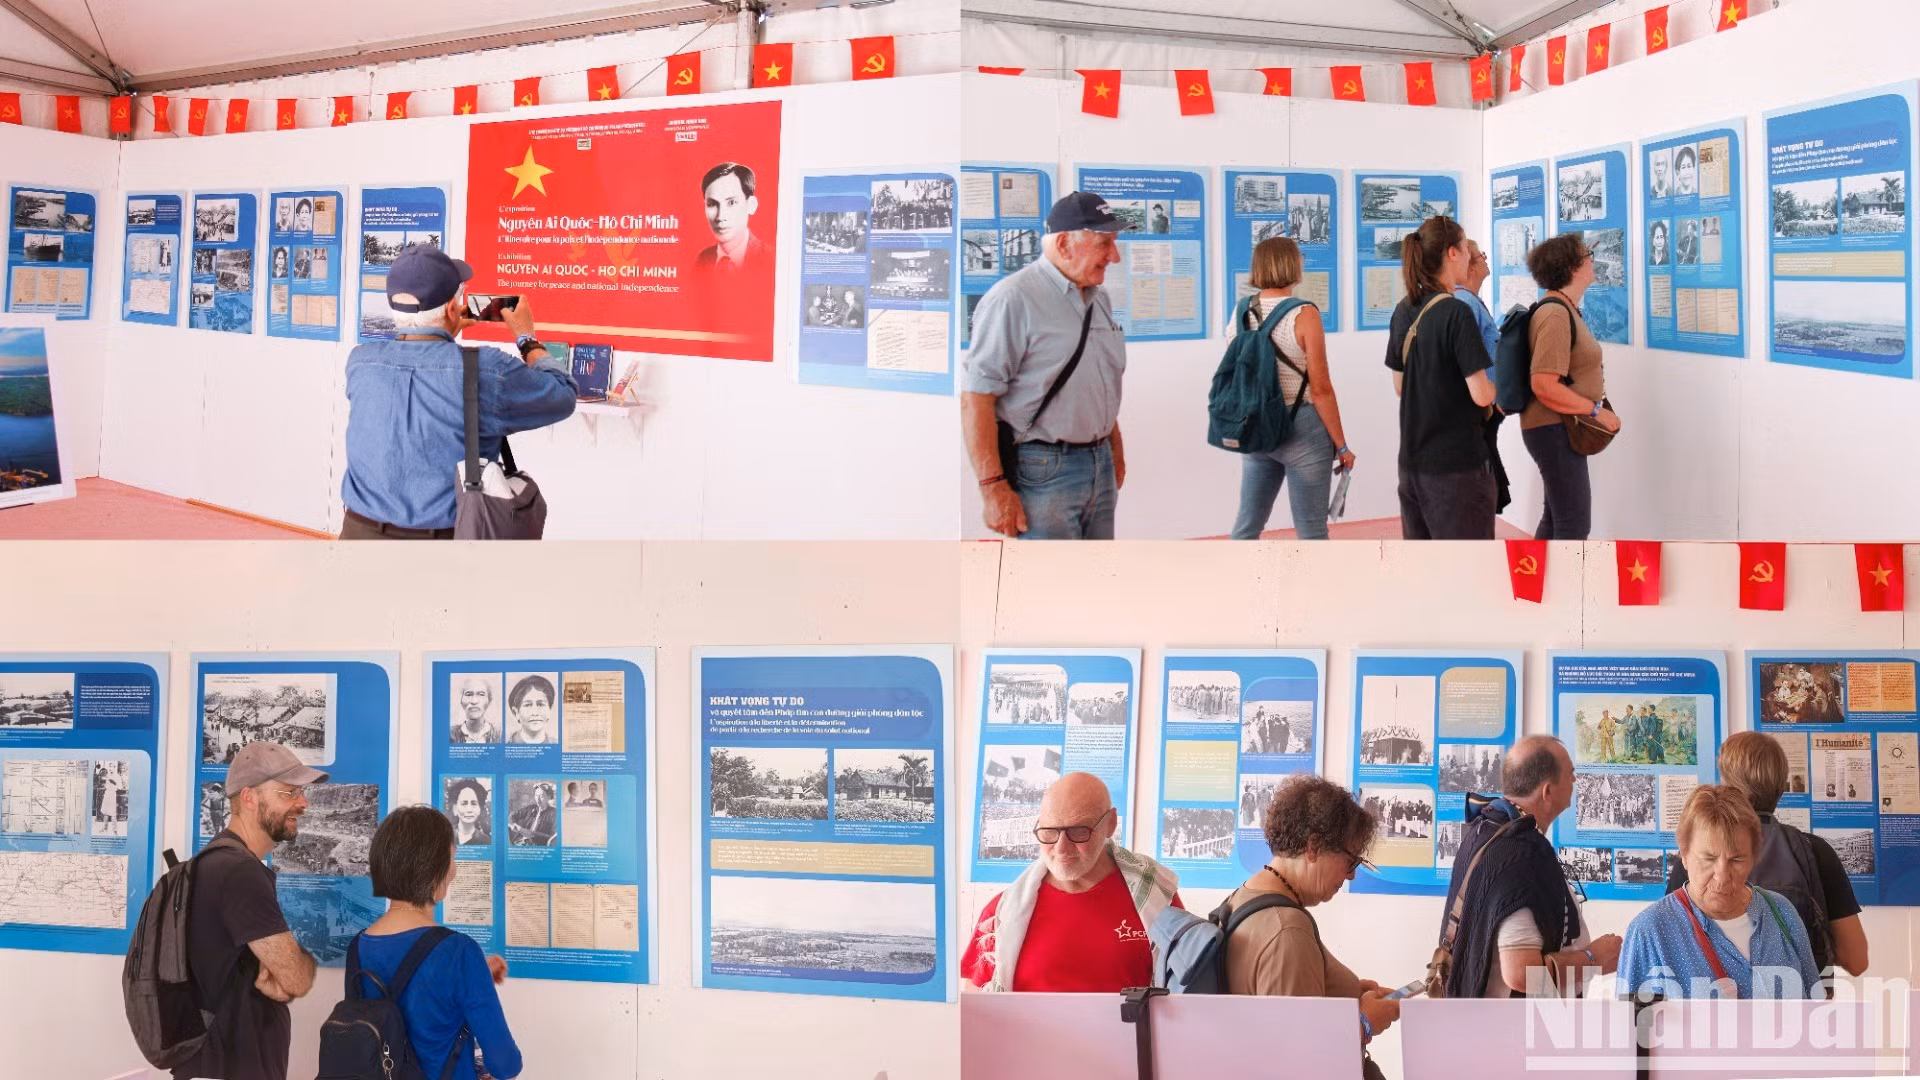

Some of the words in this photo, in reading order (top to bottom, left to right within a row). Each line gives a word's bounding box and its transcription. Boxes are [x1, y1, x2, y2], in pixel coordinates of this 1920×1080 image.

[545, 216, 557, 229] Ai
[620, 214, 643, 229] Chi
[645, 214, 679, 229] Minh
[542, 265, 552, 274] AI
[598, 265, 616, 276] HO
[619, 266, 640, 277] CHI
[643, 267, 677, 278] MINH
[497, 279, 509, 287] The
[510, 280, 538, 289] journey
[538, 280, 548, 288] for
[587, 282, 618, 290] national
[621, 283, 678, 293] independence
[772, 697, 788, 707] TỰ
[789, 697, 804, 705] DO
